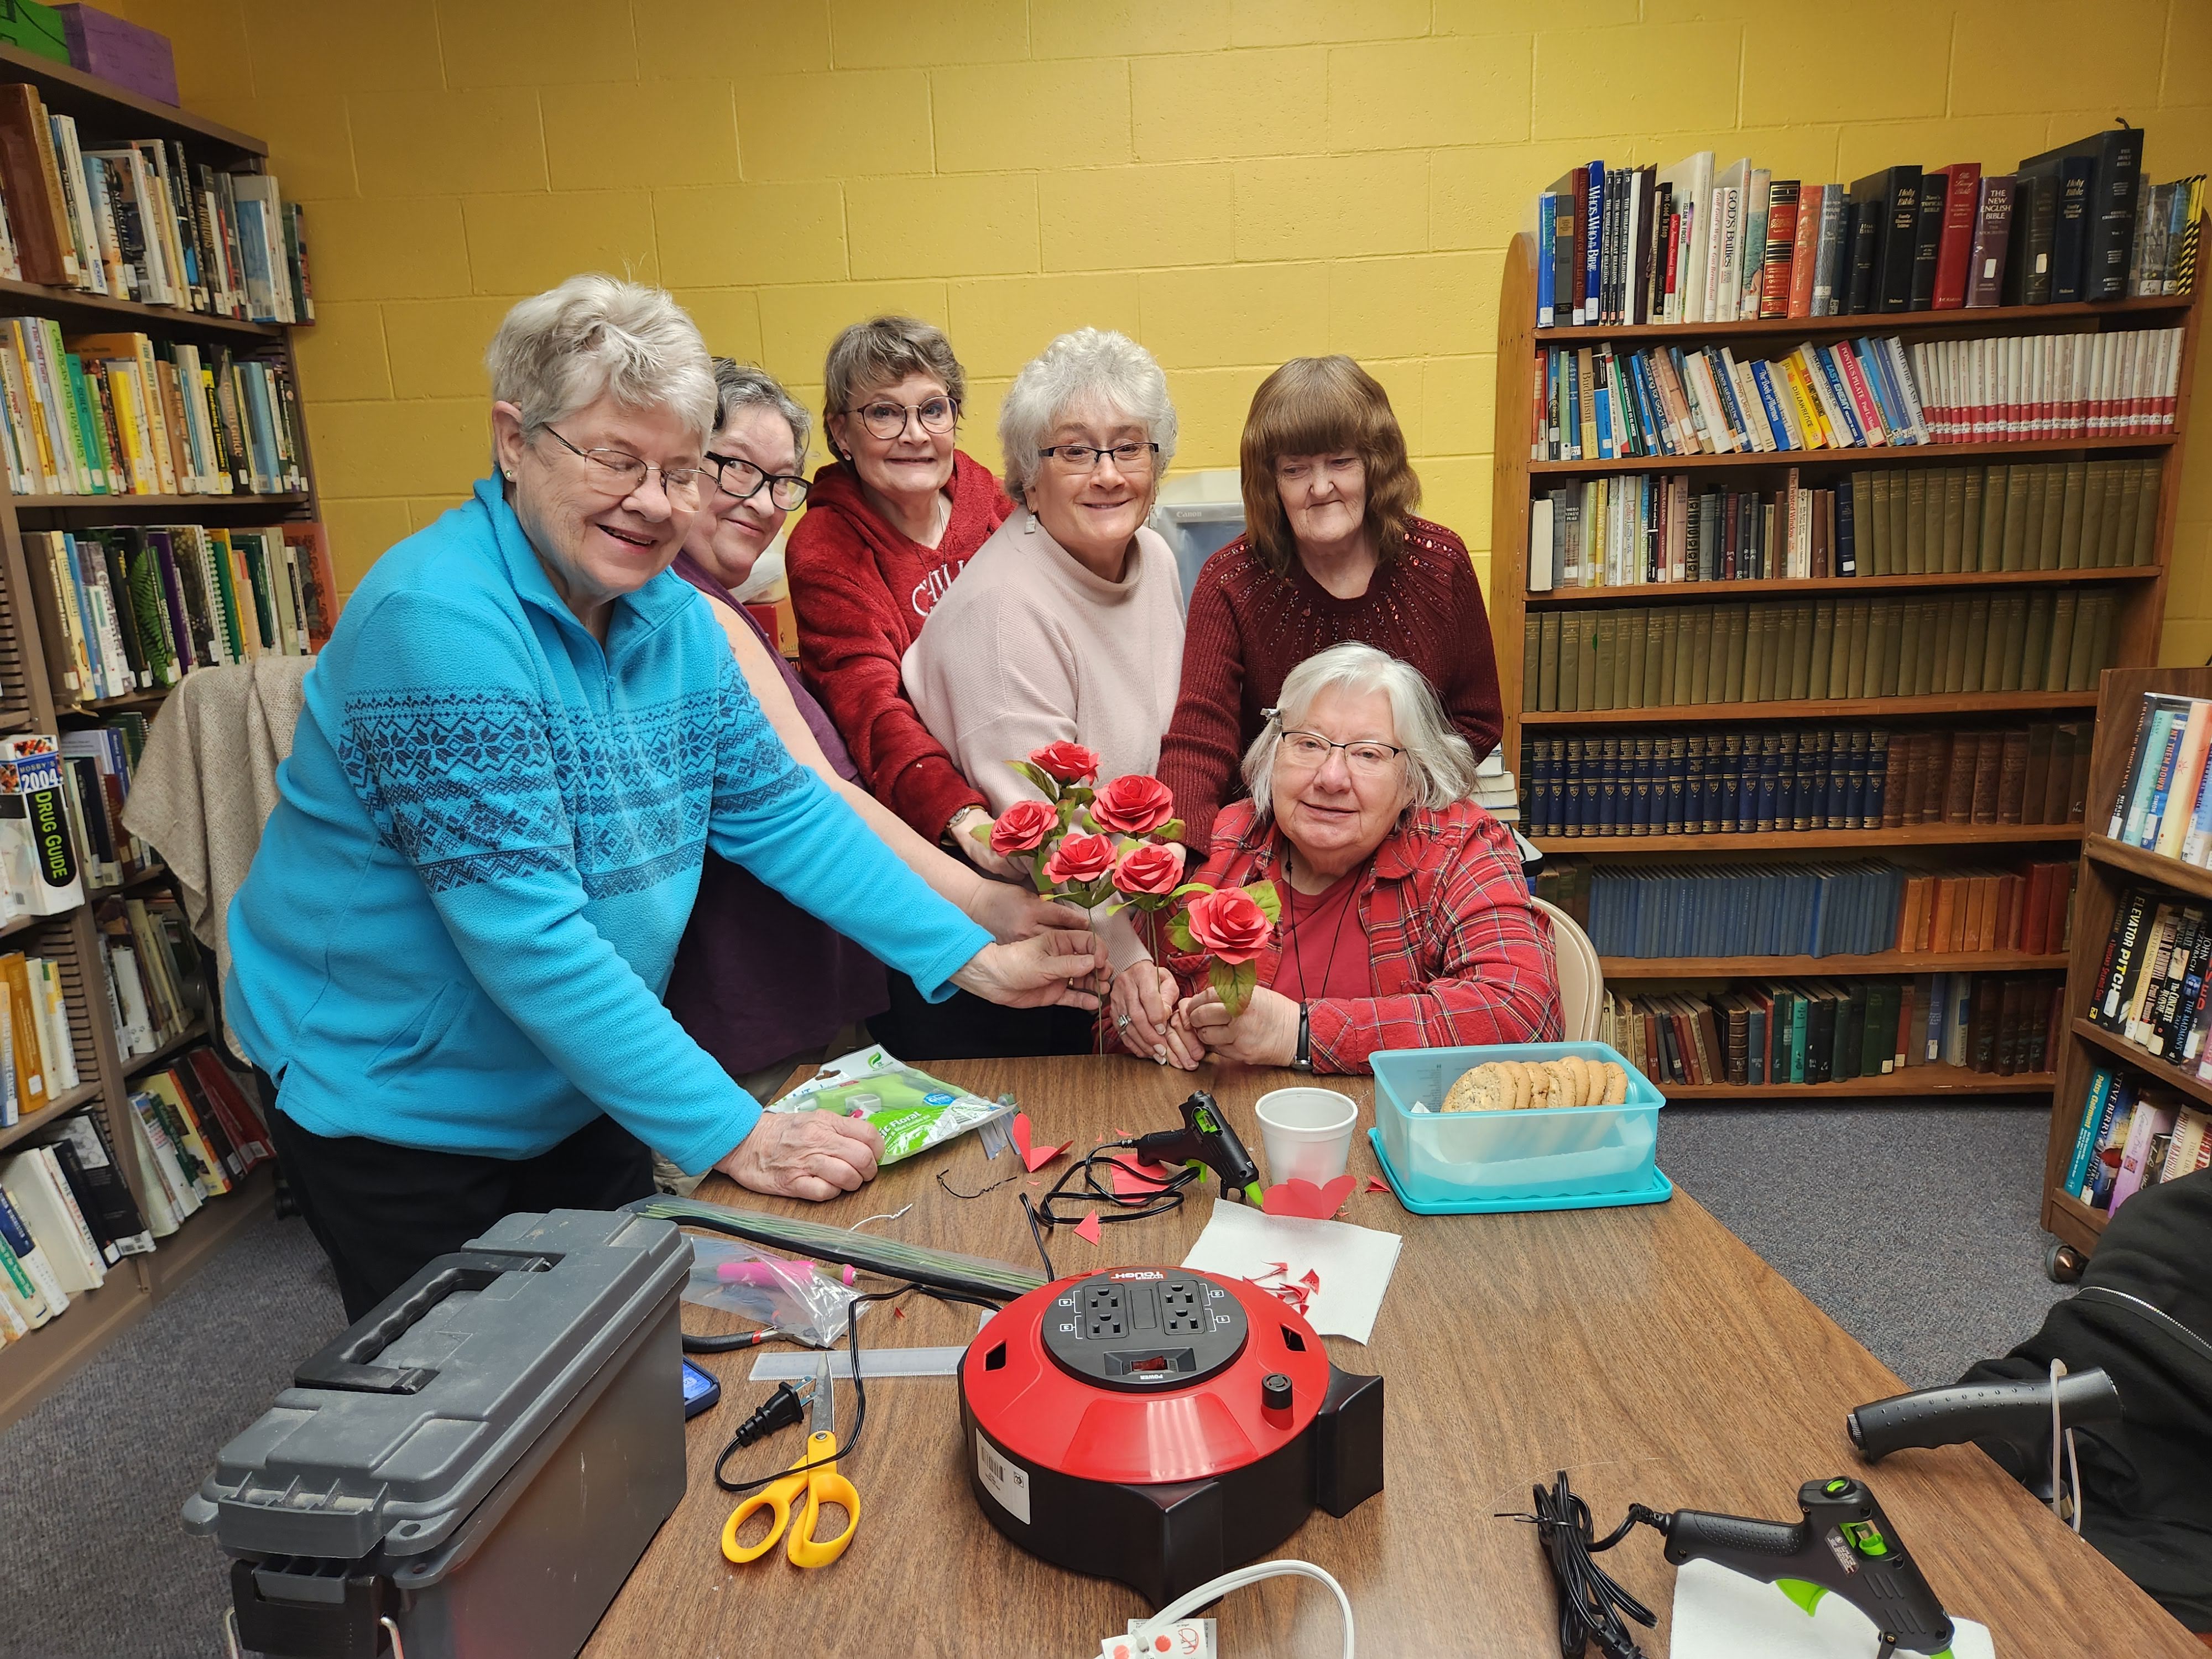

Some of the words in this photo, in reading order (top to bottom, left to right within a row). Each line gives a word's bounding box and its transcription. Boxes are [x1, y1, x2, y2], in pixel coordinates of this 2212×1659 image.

[1662, 204, 1671, 217] Good
[1681, 202, 1690, 219] ISLAM
[1728, 190, 1738, 229] GOD'S
[1897, 197, 1914, 206] Bible
[196, 206, 215, 249] AVIATORS
[1587, 216, 1600, 241] WHO
[1660, 225, 1670, 238] Keep
[1679, 227, 1688, 244] FOCUS
[1711, 228, 1721, 243] Way
[1586, 249, 1599, 272] BIBLE
[1721, 230, 1732, 268] Bullies
[1620, 254, 1628, 284] RELIGIONS
[32, 326, 40, 344] This
[35, 345, 44, 361] Old
[1894, 339, 1906, 359] STAR
[1901, 362, 1908, 370] IN
[1903, 370, 1912, 383] THE
[1642, 354, 1656, 389] Reaching
[1655, 399, 1664, 417] God
[1760, 379, 1773, 395] Book
[1815, 363, 1823, 372] OK
[1831, 400, 1839, 410] OK
[1825, 363, 1839, 384] LAST
[1834, 382, 1850, 412] ENEMY
[1841, 347, 1857, 377] PONTIUS
[1851, 375, 1865, 400] PILATE
[1861, 401, 1870, 414] Paul
[1582, 372, 1594, 422] Buddhism
[1906, 384, 1919, 404] EAST
[1766, 400, 1782, 421] Mormon
[1796, 396, 1813, 428] LAWRENCE
[229, 424, 244, 457] Guide
[1598, 504, 1605, 514] TO
[1789, 486, 1798, 510] Twisted
[1598, 515, 1605, 529] MY
[1788, 512, 1796, 538] Window
[1597, 529, 1605, 548] SON
[2162, 742, 2175, 765] THEM
[19, 761, 55, 773] MOSBY'S
[2156, 766, 2169, 791] DOWN
[22, 768, 56, 792] 2004
[34, 791, 57, 833] DRUG
[2151, 794, 2159, 813] SIMON
[45, 835, 68, 879] GUIDE
[2122, 895, 2145, 947] ELEVATOR
[2146, 941, 2157, 970] PEARSON
[2199, 936, 2212, 961] JOHN
[2110, 948, 2131, 993] PITCH
[2170, 982, 2180, 992] The
[2162, 992, 2179, 1022] CONCRETE
[2184, 999, 2195, 1013] THE
[2174, 1014, 2190, 1051] MADMAN'S
[2093, 1074, 2105, 1093] Patsy
[2109, 1071, 2125, 1103] STEVE
[928, 1094, 950, 1104] Glue
[890, 1111, 922, 1128] Floral
[2083, 1094, 2099, 1128] Clairmont
[2099, 1103, 2115, 1138] BERRY
[60, 1181, 72, 1197] THE
